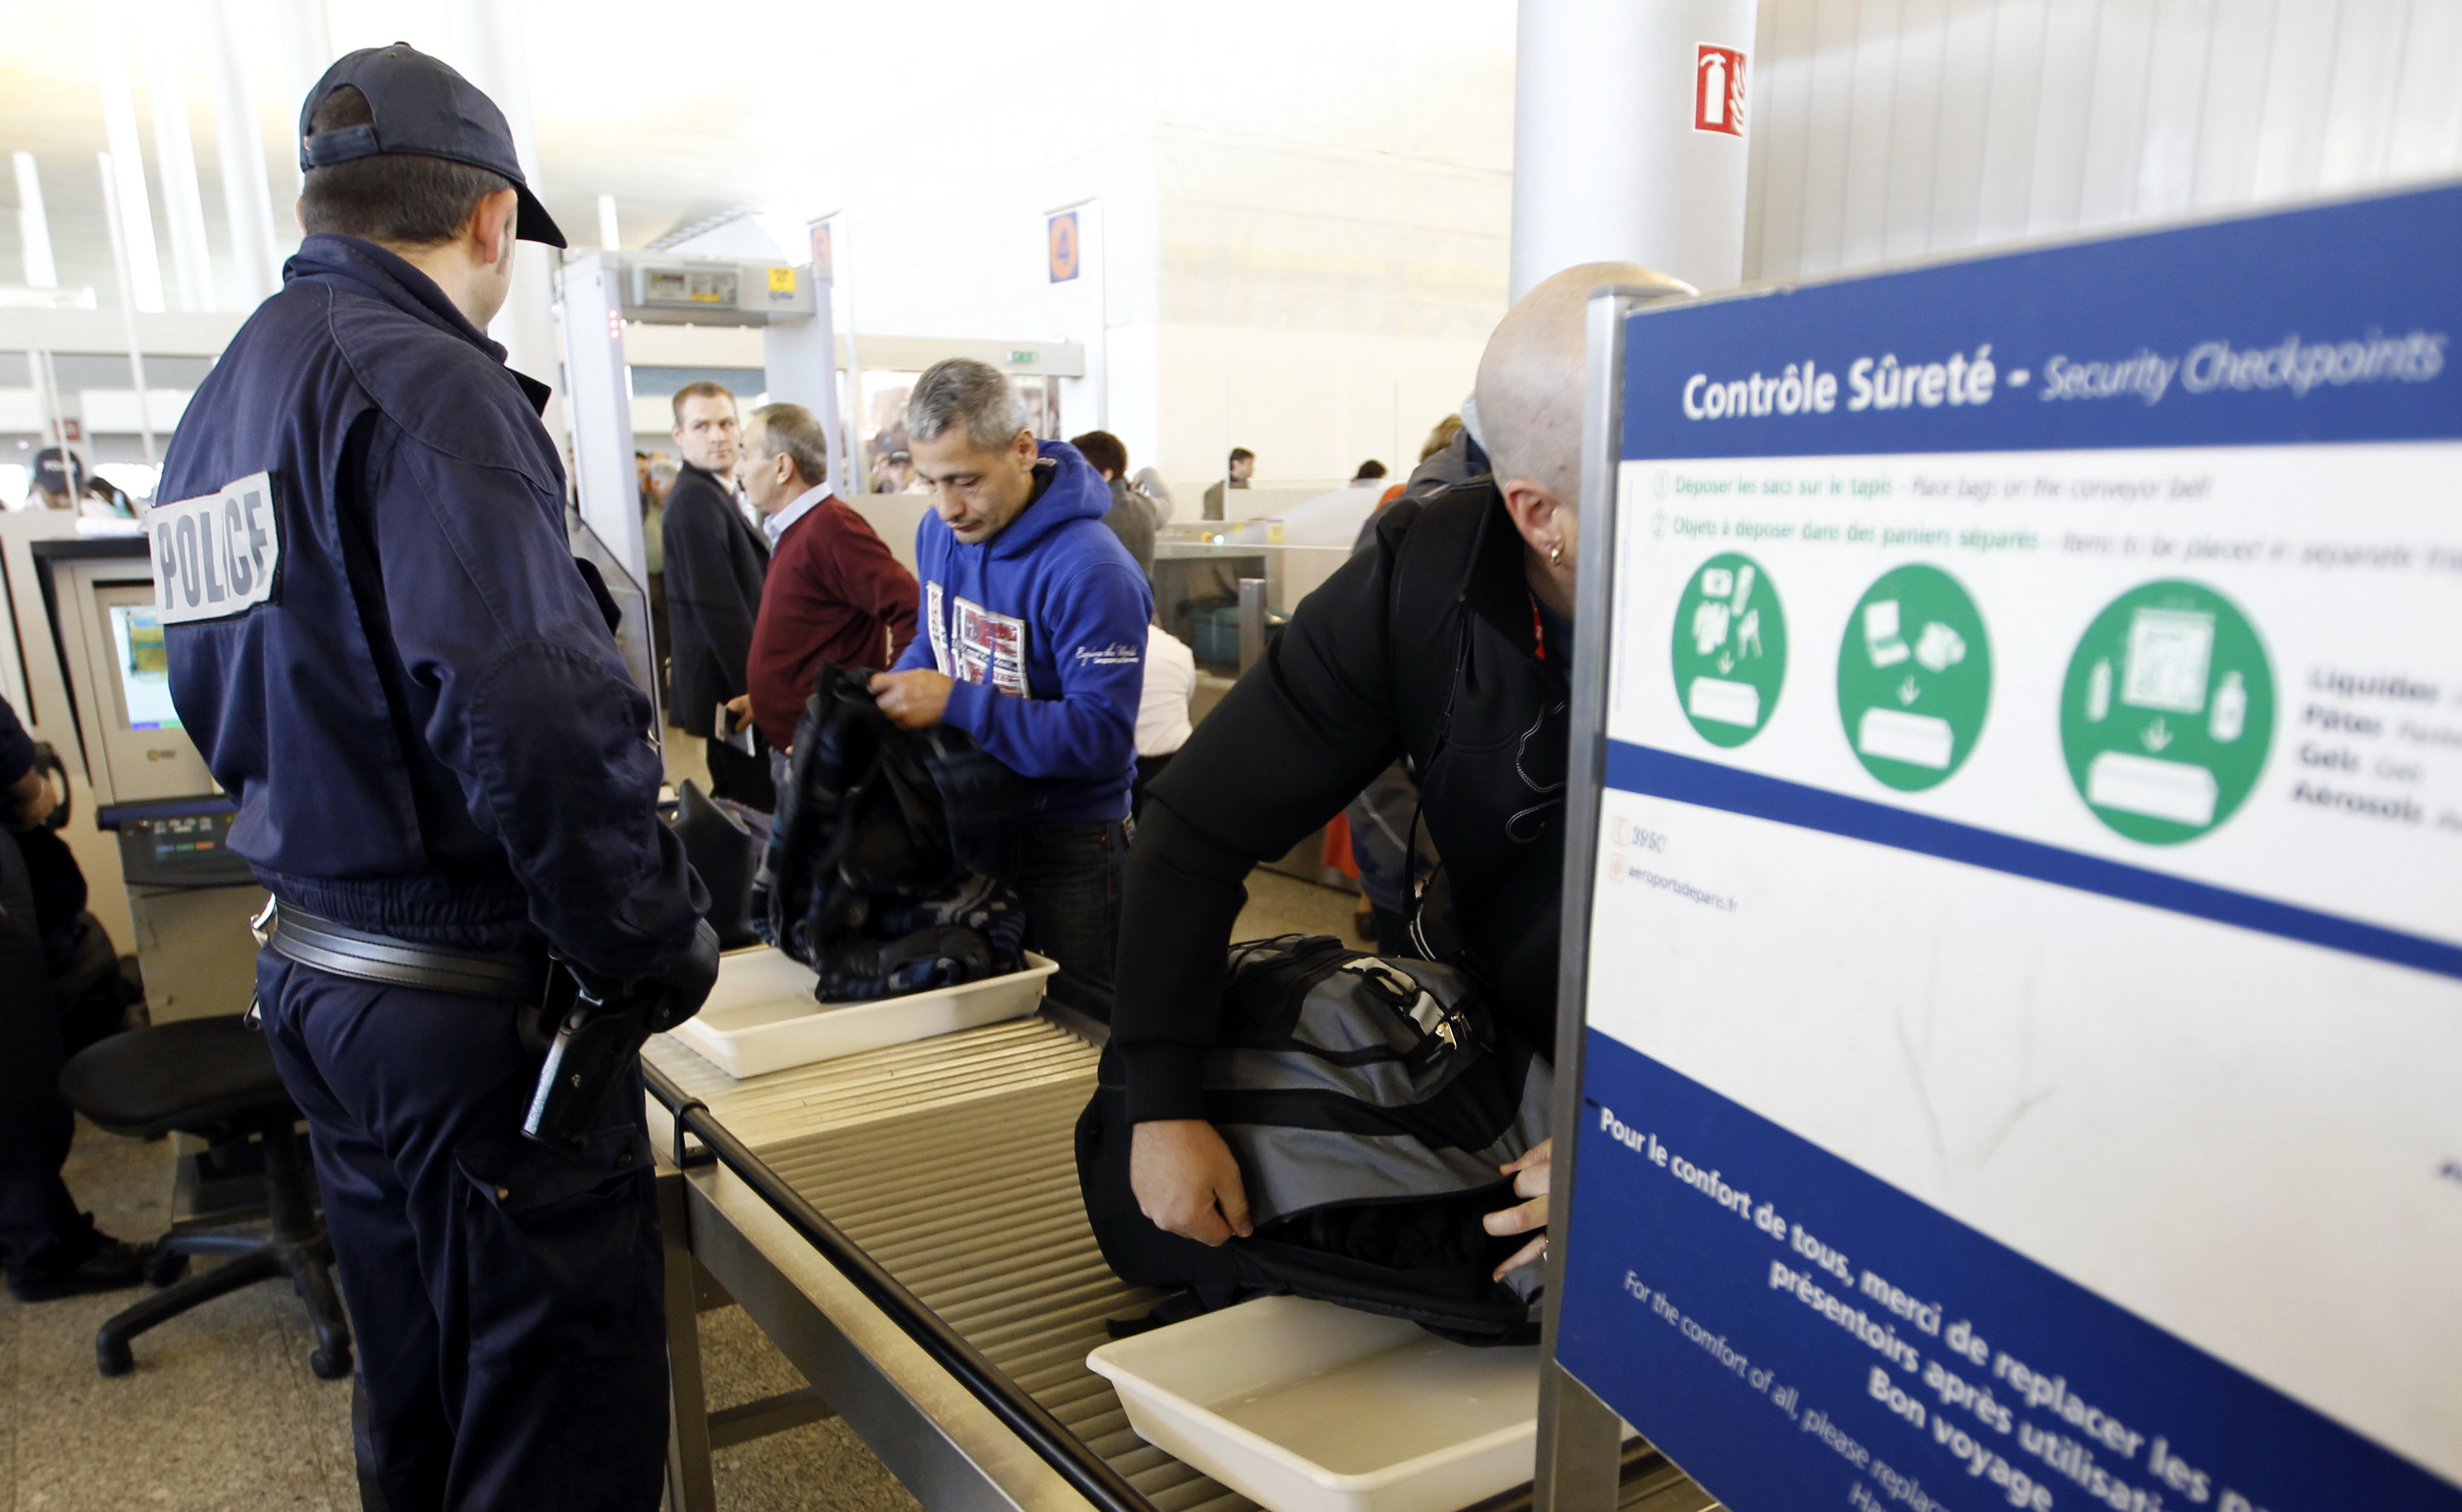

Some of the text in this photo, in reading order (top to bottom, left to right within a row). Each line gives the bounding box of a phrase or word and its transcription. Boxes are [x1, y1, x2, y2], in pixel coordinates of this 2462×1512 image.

[1057, 227, 1070, 267] 4
[1683, 361, 1837, 420] Contrôle
[1848, 343, 1996, 411] Sûreté
[2038, 347, 2179, 407] Security
[2181, 327, 2448, 399] Checkpoints
[1600, 1106, 1646, 1153] Pour
[1647, 1133, 1668, 1168] le
[1670, 1155, 1753, 1221] confort
[1753, 1202, 1787, 1241] de
[1790, 1223, 1854, 1287] tous,
[1859, 1271, 1942, 1335] merci
[1945, 1319, 1989, 1367] de
[1992, 1351, 2145, 1459] replacer
[2148, 1434, 2211, 1503] les
[1624, 1269, 1652, 1302] For
[1651, 1292, 1680, 1326] the
[1679, 1315, 1750, 1379] comfort
[1747, 1366, 1776, 1394] of
[1770, 1383, 1799, 1421] all,
[1801, 1410, 1870, 1470] please
[1768, 1259, 1920, 1373] présentoirs
[1922, 1360, 2014, 1435] après
[1868, 1364, 2053, 1512] Bon voyage
